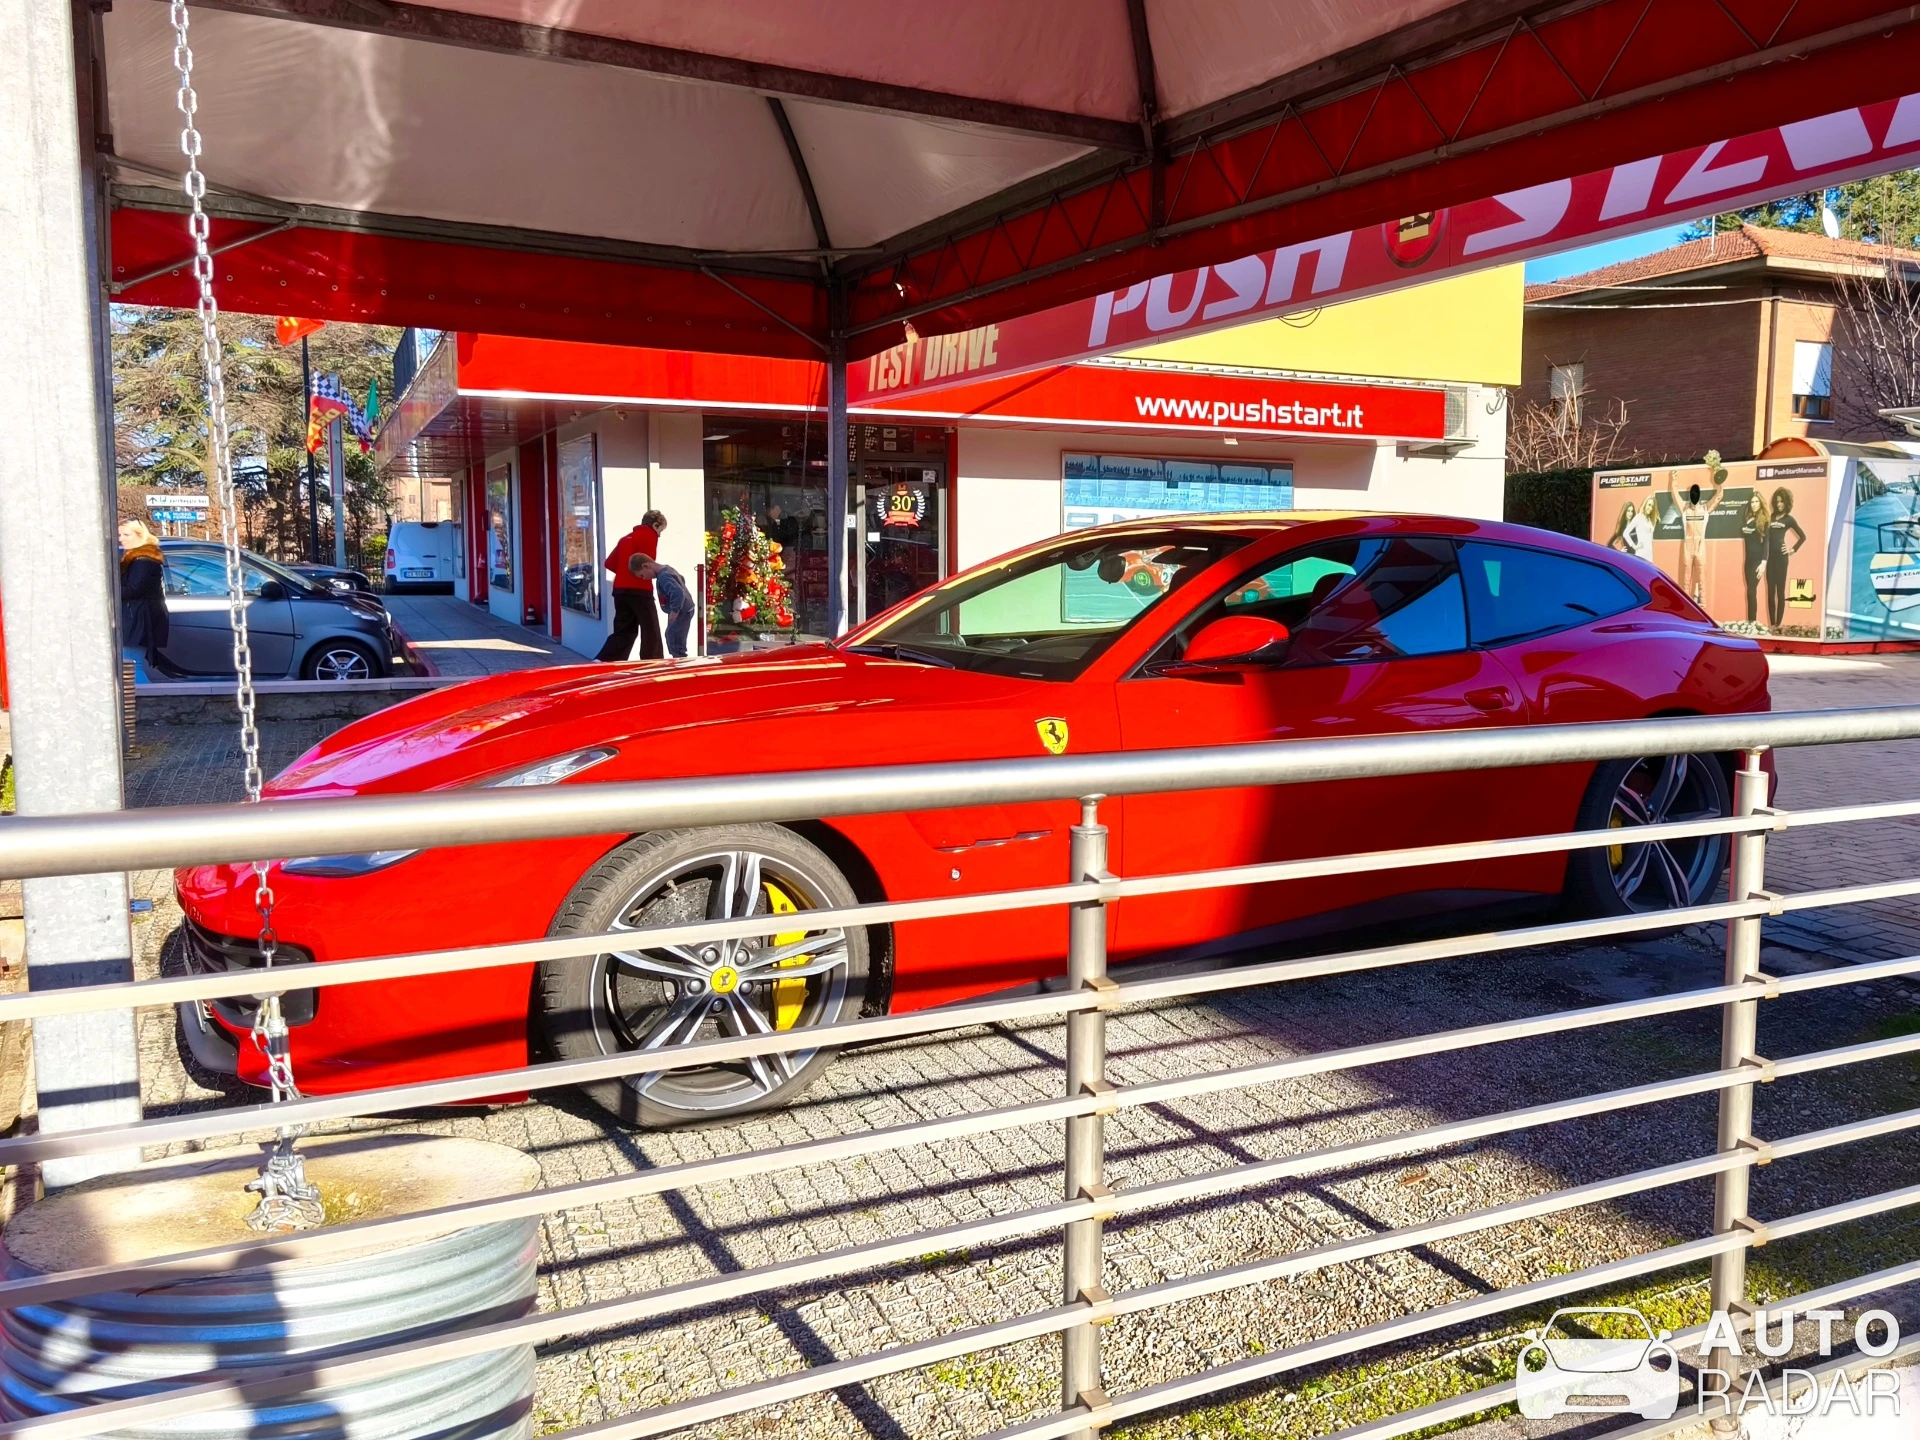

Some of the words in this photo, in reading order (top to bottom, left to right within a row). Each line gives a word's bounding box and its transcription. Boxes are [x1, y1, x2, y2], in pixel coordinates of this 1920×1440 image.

[924, 323, 999, 381] DRIVE
[1135, 396, 1363, 428] www.pushstart.it
[1600, 477, 1620, 485] PUSH
[1626, 475, 1650, 483] START
